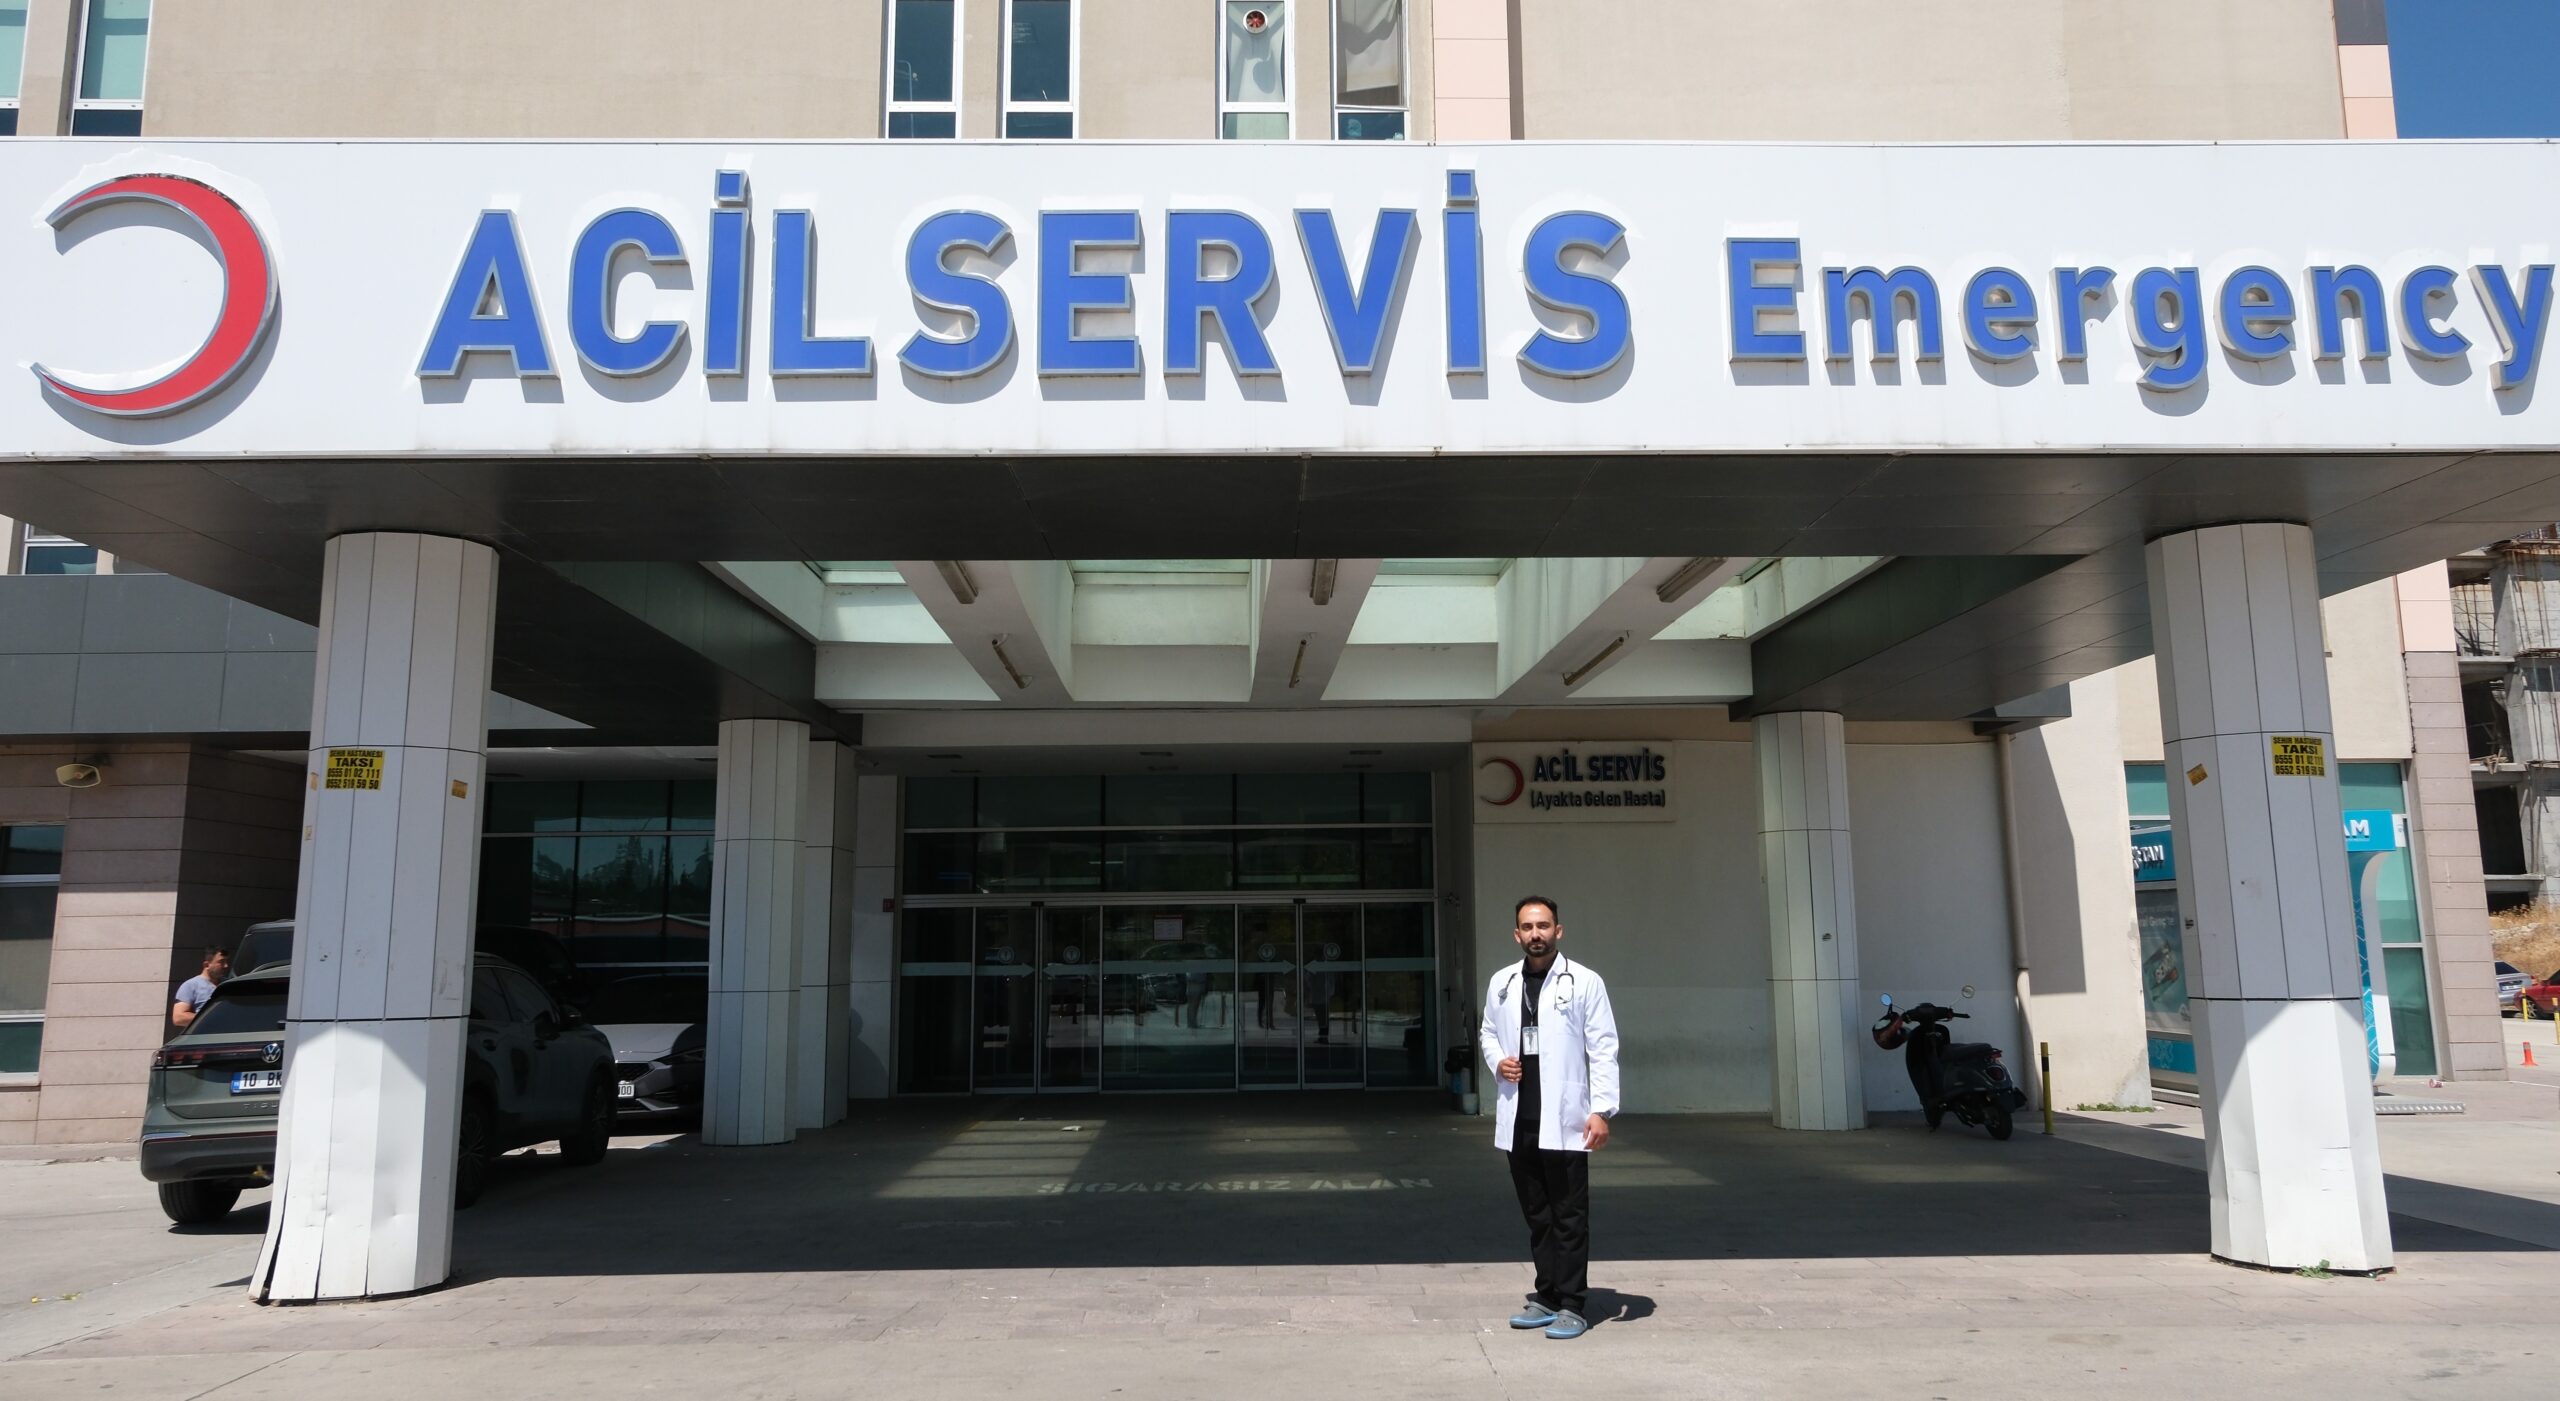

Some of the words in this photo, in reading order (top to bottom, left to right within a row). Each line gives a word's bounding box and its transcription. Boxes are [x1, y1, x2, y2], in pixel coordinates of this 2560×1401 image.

[1725, 236, 2557, 394] Emergency
[1533, 747, 1584, 782] ACİL
[1587, 747, 1666, 782] SERVİS
[1530, 790, 1582, 810] (Ayakta
[1584, 790, 1621, 807] Gelen
[1624, 789, 1666, 808] Hasta)
[242, 1072, 258, 1088] 10
[1307, 1177, 1434, 1191] ALAN
